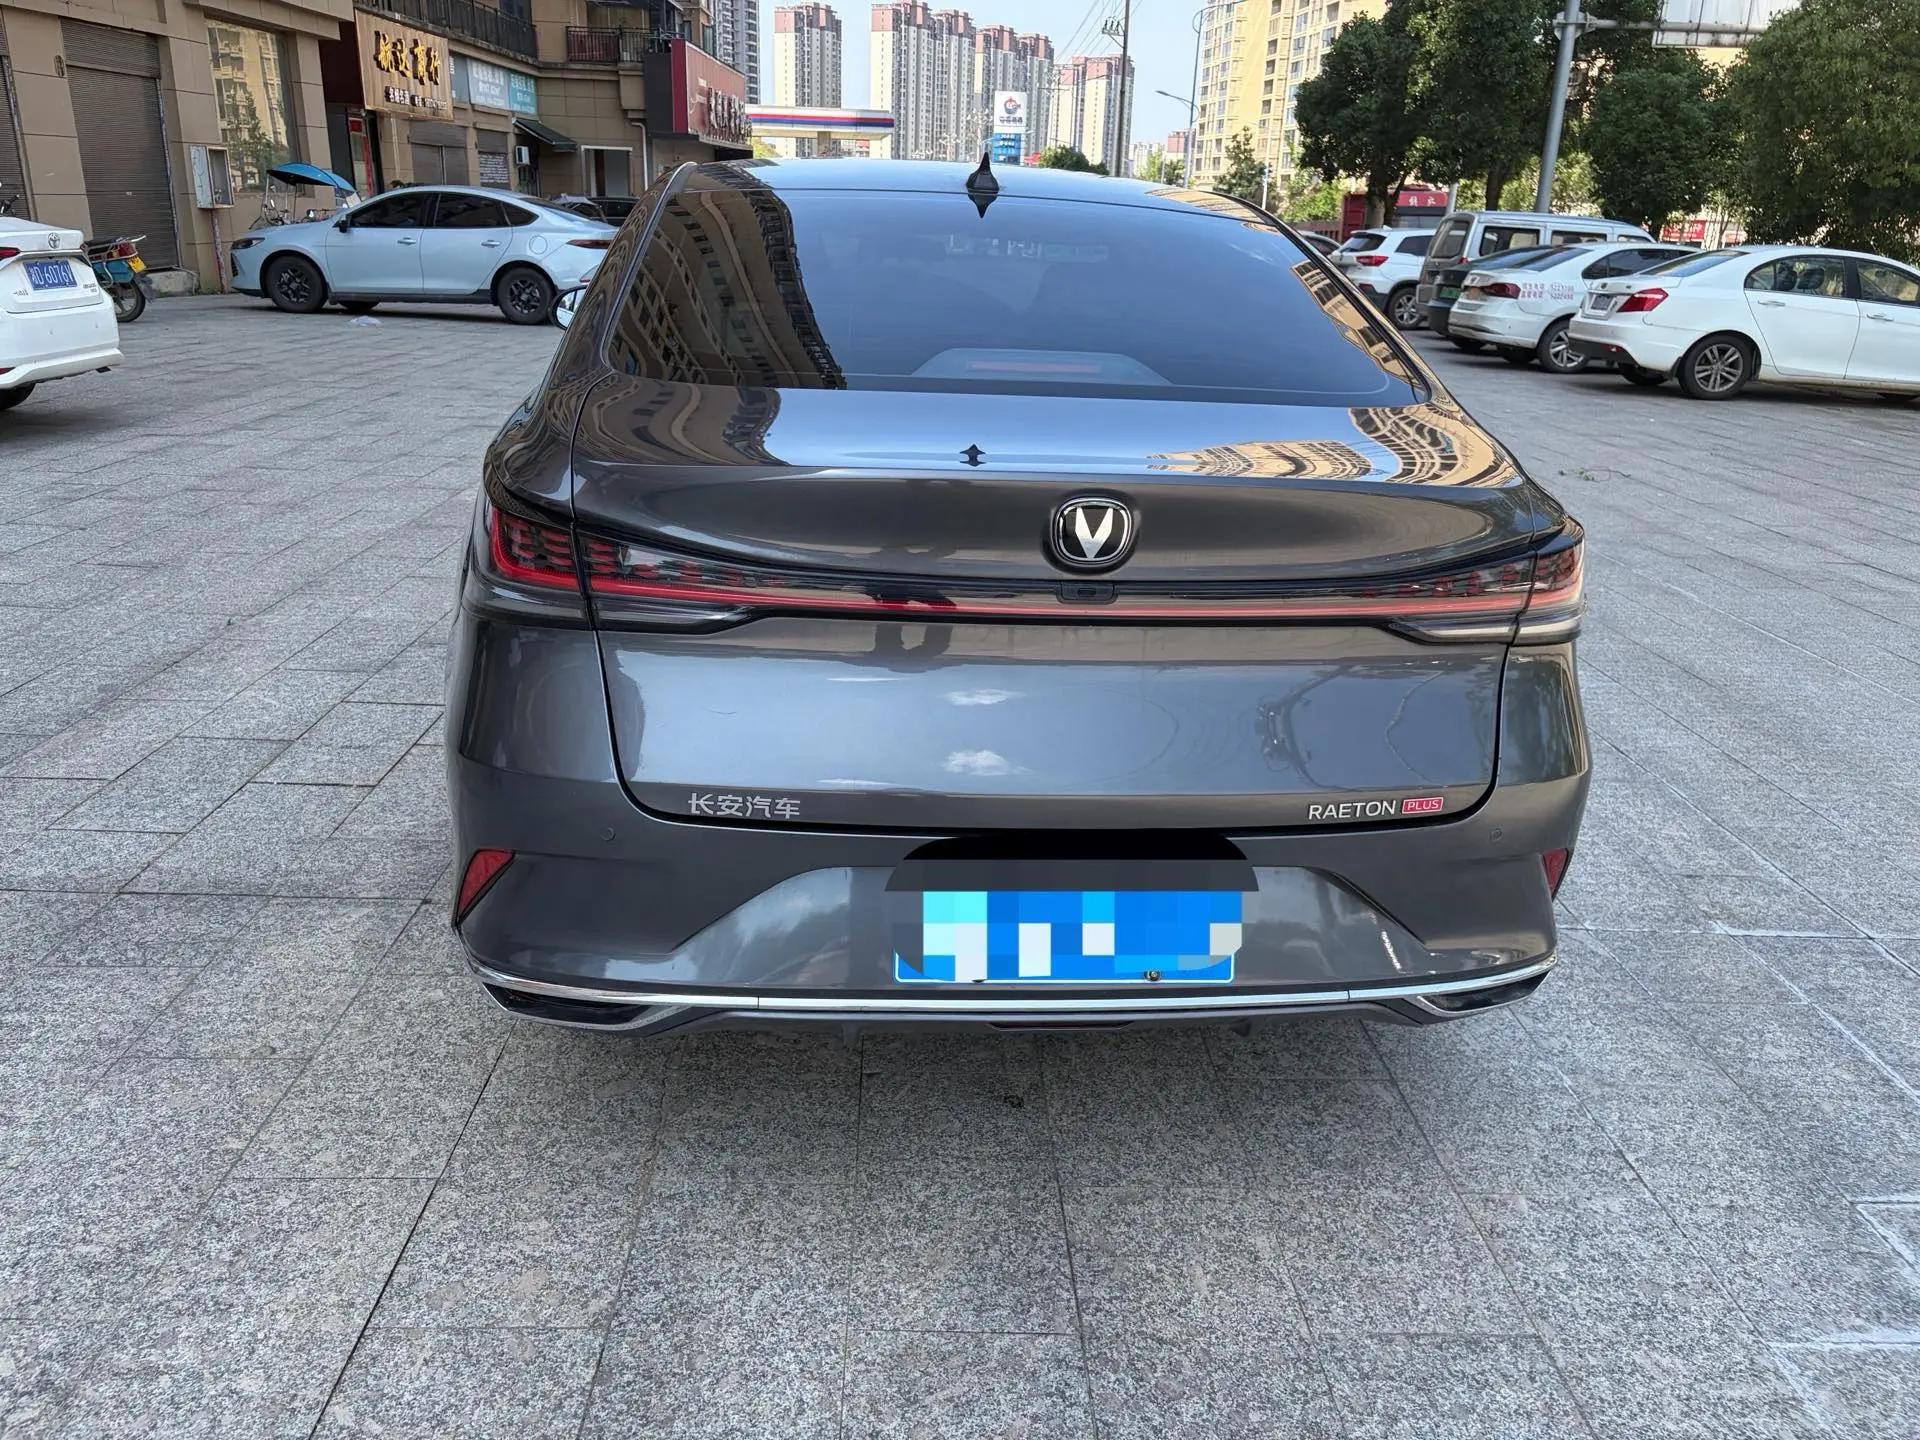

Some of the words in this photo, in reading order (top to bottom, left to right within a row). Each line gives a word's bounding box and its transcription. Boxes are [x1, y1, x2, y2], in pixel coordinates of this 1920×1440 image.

[687, 792, 801, 820] 长安汽车
[1308, 800, 1397, 820] RAETON
[1406, 799, 1440, 811] PLUS
